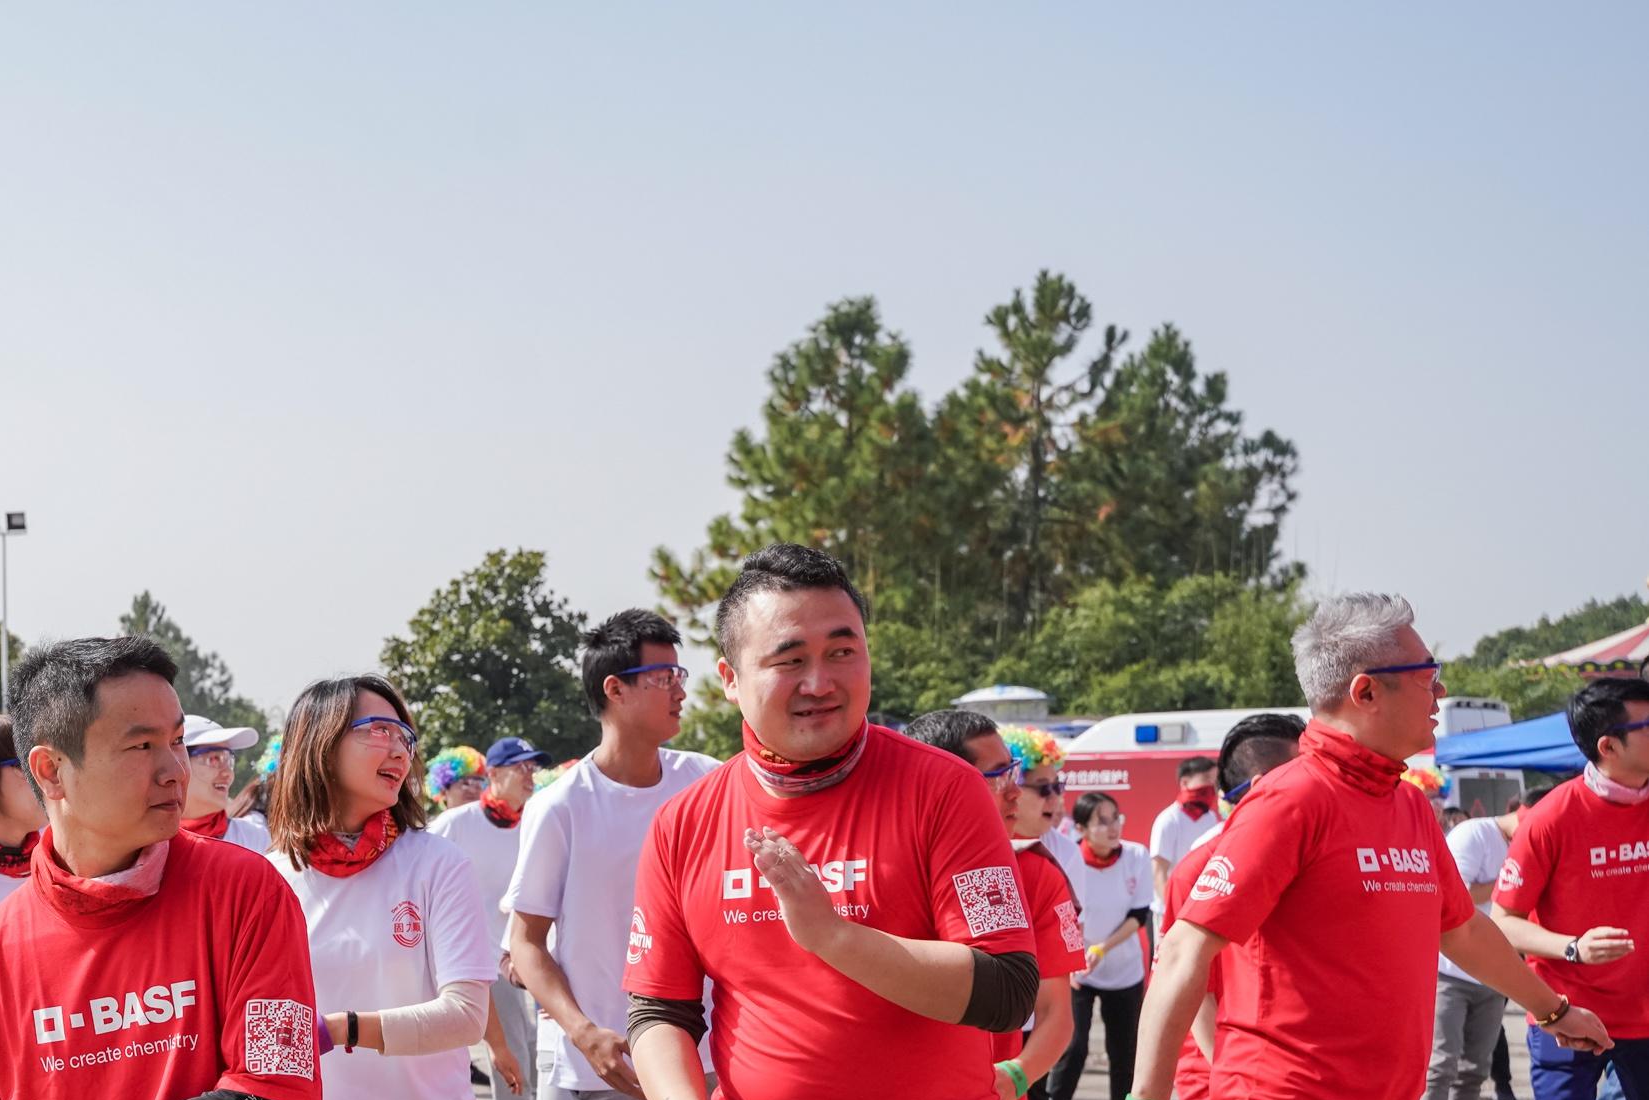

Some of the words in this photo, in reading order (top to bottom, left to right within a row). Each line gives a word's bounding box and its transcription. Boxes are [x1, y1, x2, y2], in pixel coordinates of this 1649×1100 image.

[808, 858, 868, 893] SF
[1362, 879, 1382, 893] We
[1383, 881, 1406, 892] create
[1406, 880, 1439, 896] chemistry
[722, 908, 749, 926] We
[751, 909, 785, 923] crea
[833, 902, 870, 919] istry
[89, 979, 196, 1036] BASF
[39, 1055, 65, 1074] We
[69, 1046, 123, 1070] create
[124, 1033, 200, 1059] chemistry
